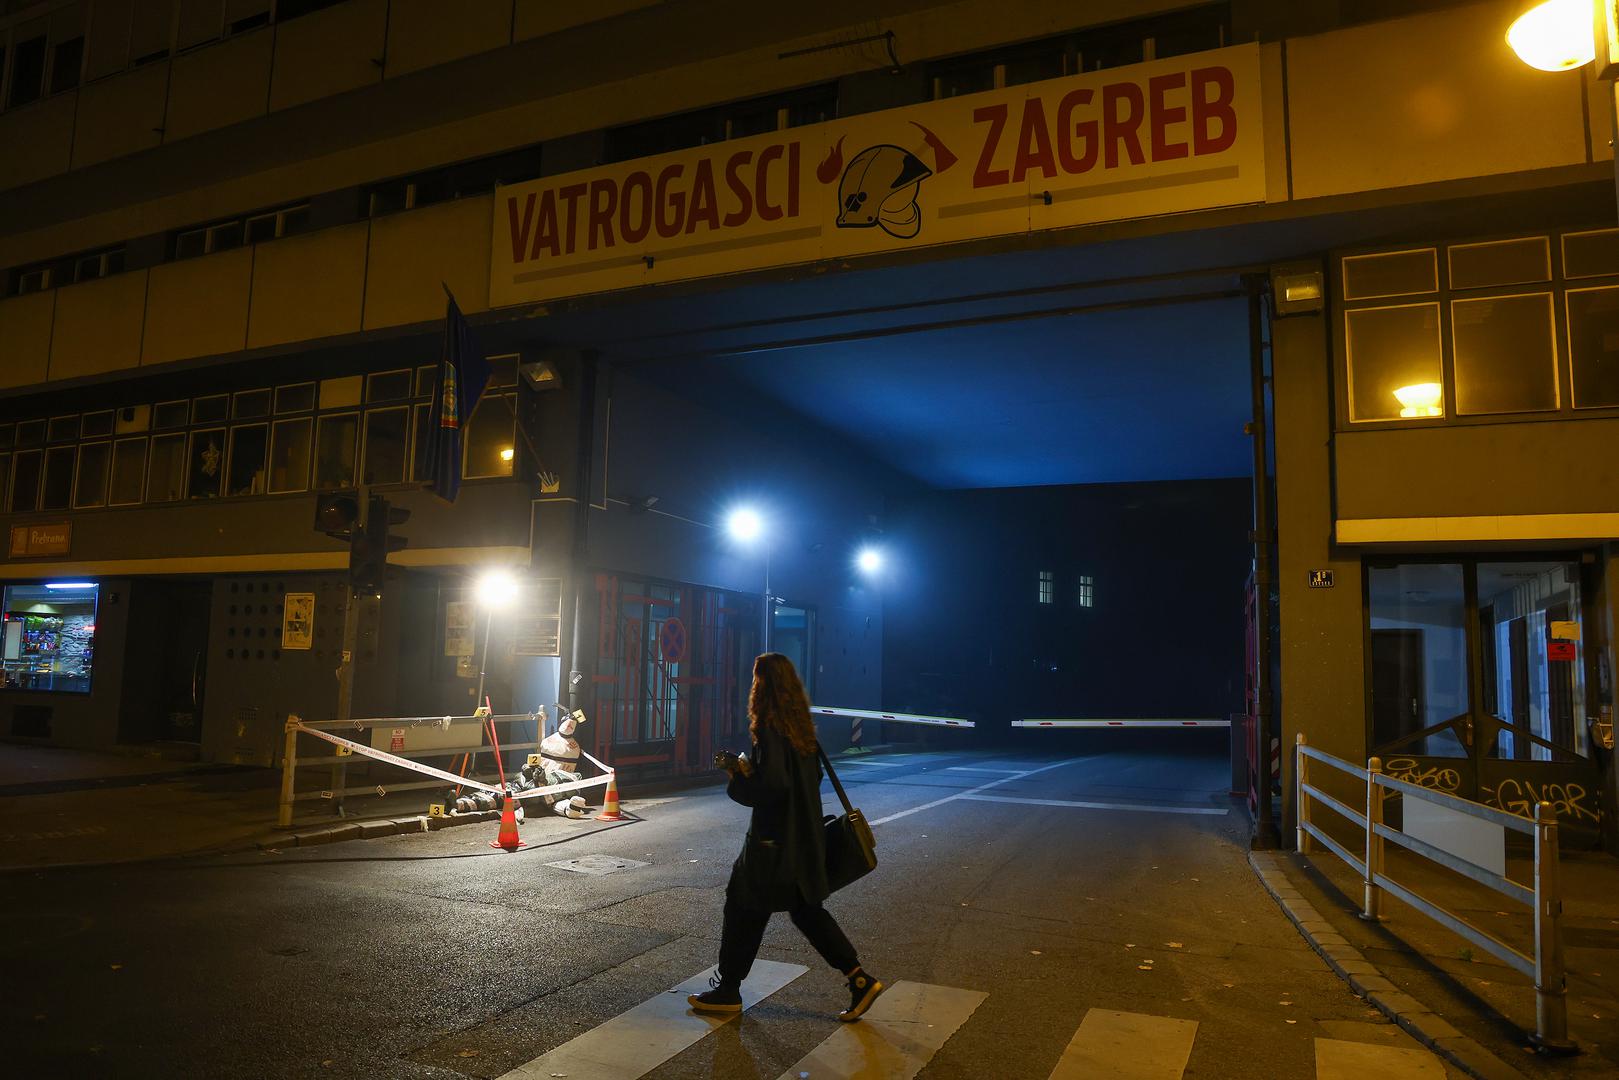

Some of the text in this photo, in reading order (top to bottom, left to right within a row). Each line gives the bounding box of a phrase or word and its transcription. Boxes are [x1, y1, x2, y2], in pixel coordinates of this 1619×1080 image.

[508, 66, 1237, 263] VATROGASCI ZAGREB
[531, 755, 539, 765] 2
[433, 806, 440, 816] 3
